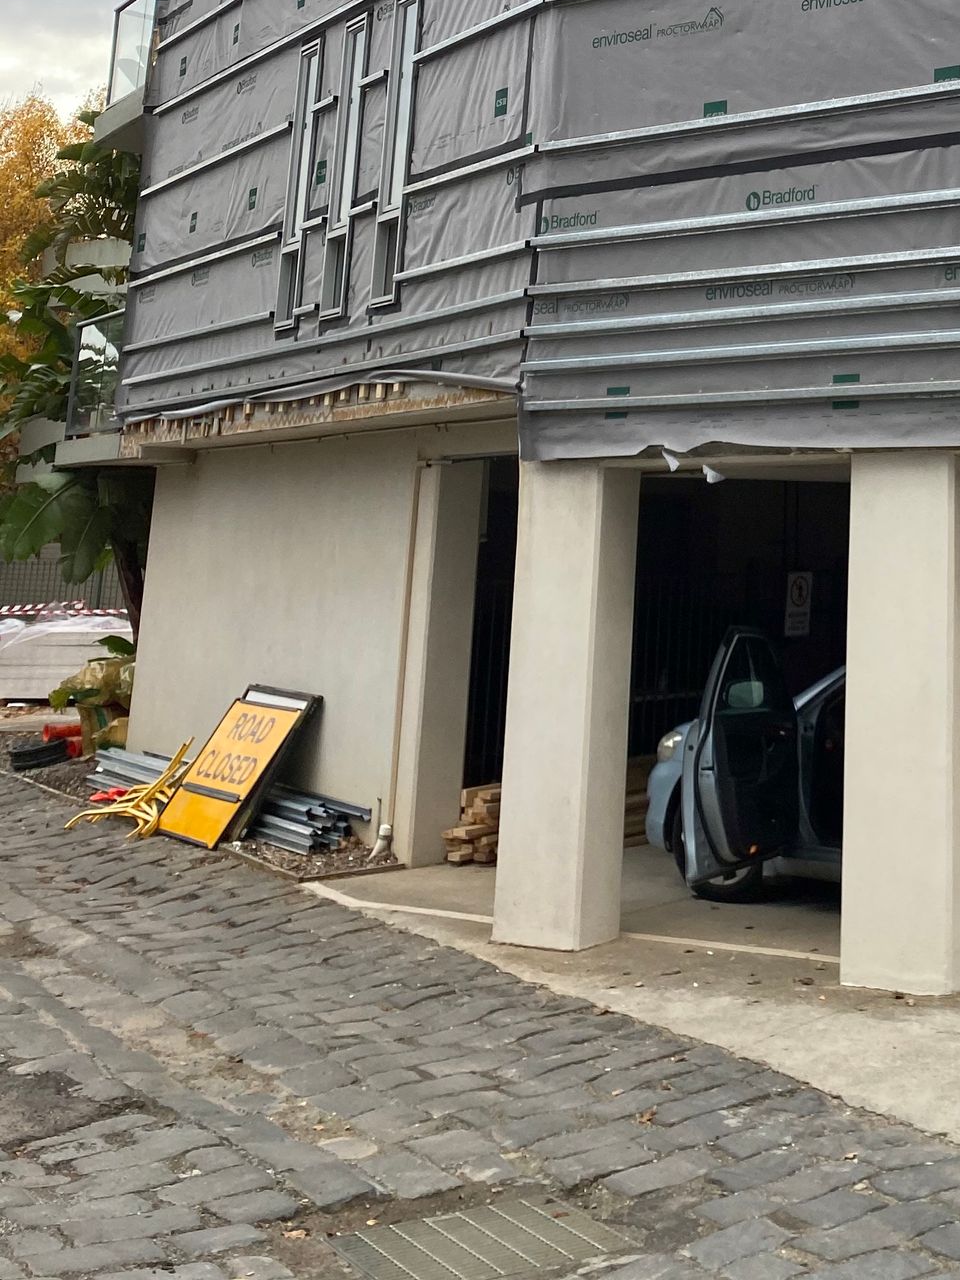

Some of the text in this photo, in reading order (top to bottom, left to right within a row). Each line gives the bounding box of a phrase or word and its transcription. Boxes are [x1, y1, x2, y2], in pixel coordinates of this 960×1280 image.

[592, 19, 720, 49] enviroseal PROCTORWRAP
[762, 186, 816, 206] Bradford
[550, 212, 598, 230] Bradford
[704, 278, 851, 300] enviroseal PROCTORWRAP
[227, 713, 276, 743] ROAD
[196, 749, 257, 785] CLOSED
